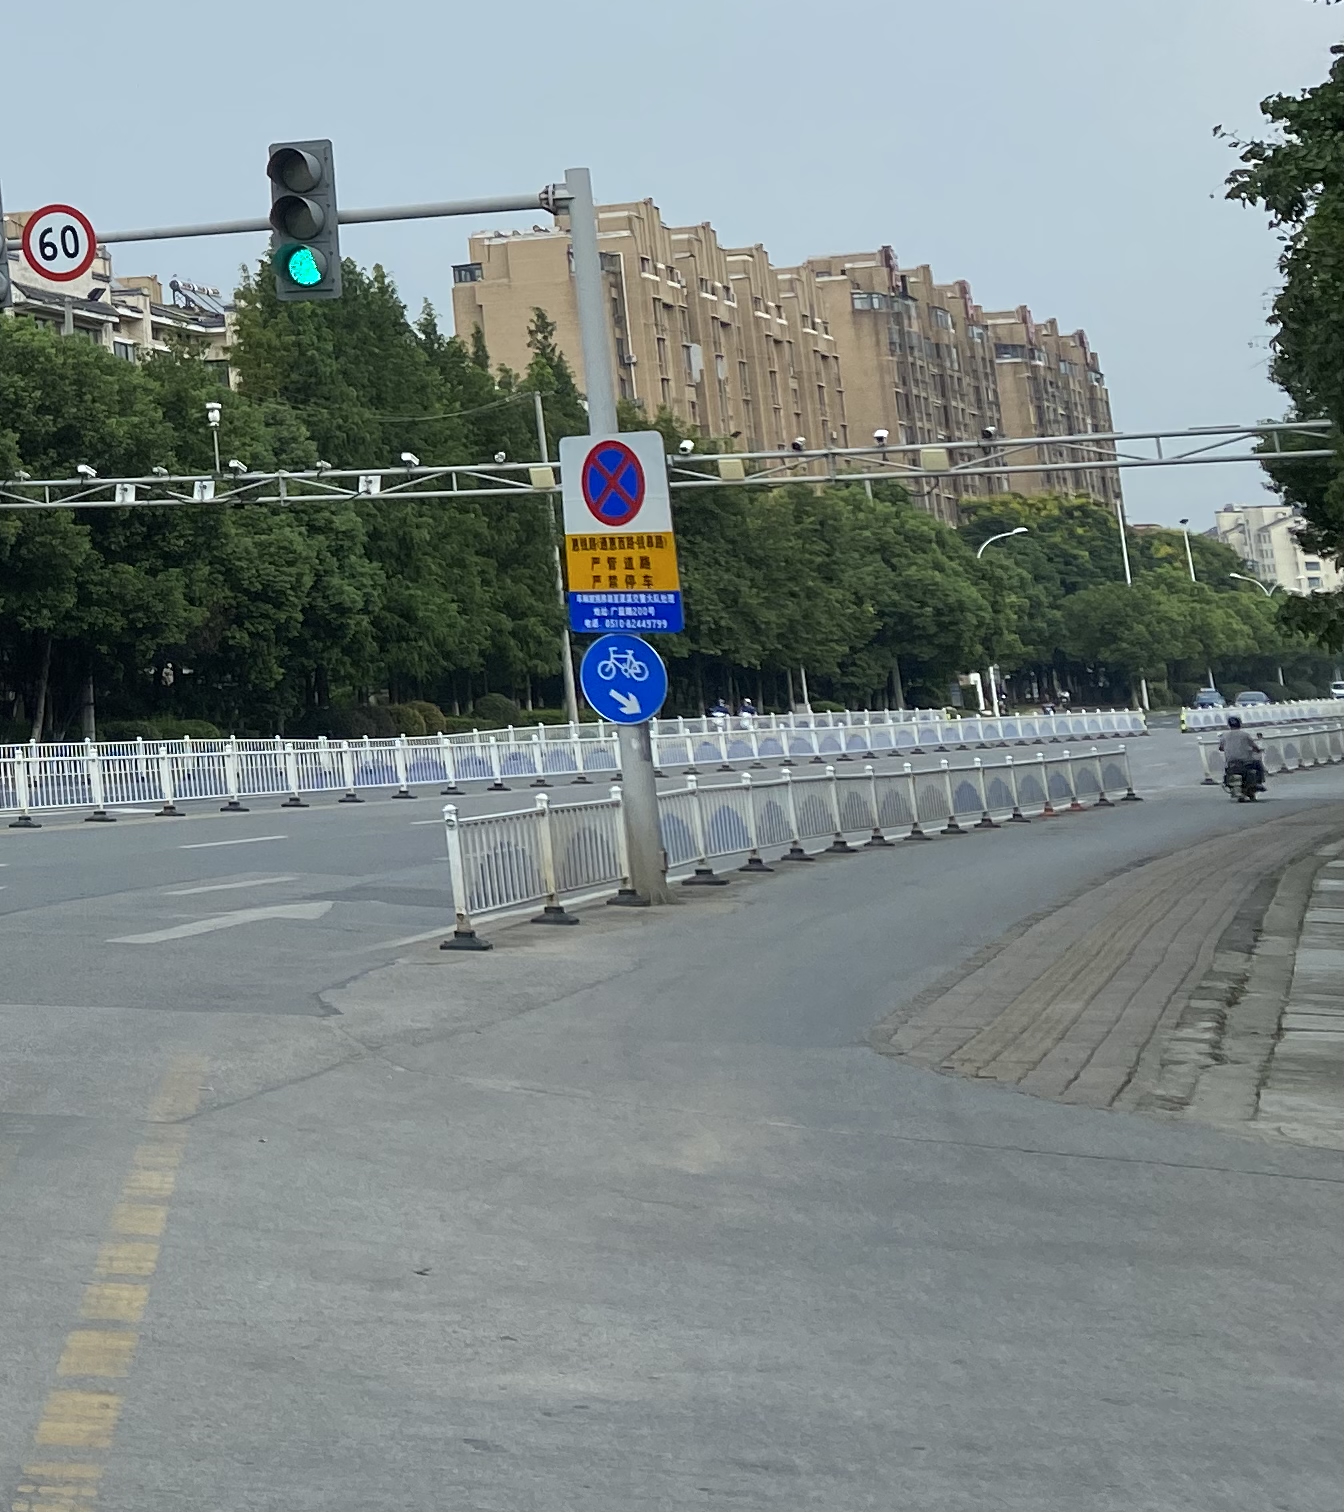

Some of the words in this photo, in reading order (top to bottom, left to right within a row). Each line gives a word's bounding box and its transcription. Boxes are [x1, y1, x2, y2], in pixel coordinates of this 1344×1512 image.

[39, 225, 79, 261] 60
[591, 555, 651, 571] 严管道路
[592, 574, 654, 589] 严禁停车
